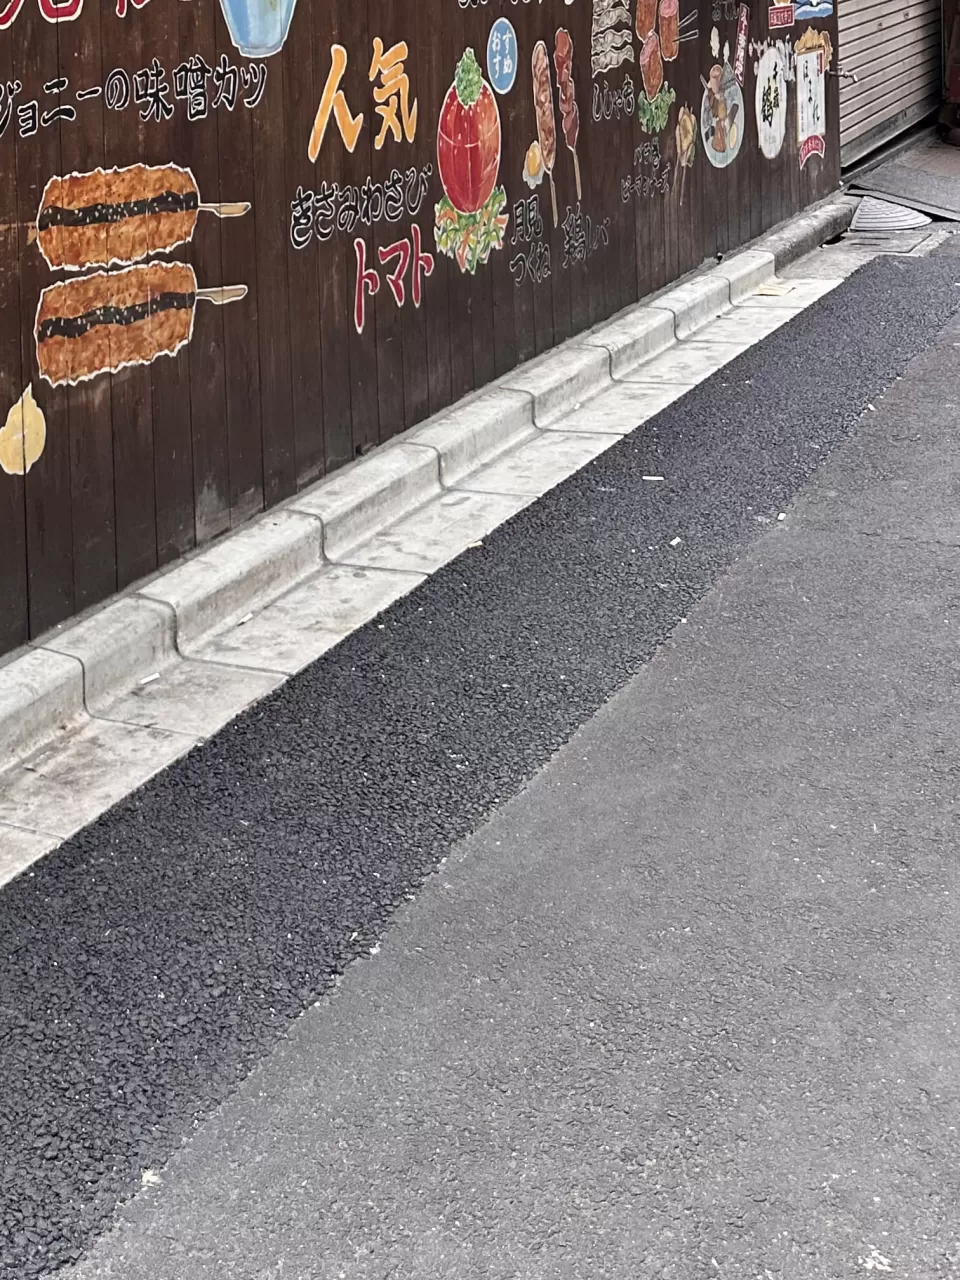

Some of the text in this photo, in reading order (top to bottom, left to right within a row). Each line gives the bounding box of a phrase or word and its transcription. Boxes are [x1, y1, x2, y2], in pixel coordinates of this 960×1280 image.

[308, 37, 417, 163] 人気
[291, 162, 433, 249] きざみわさび
[354, 223, 434, 334] トマト
